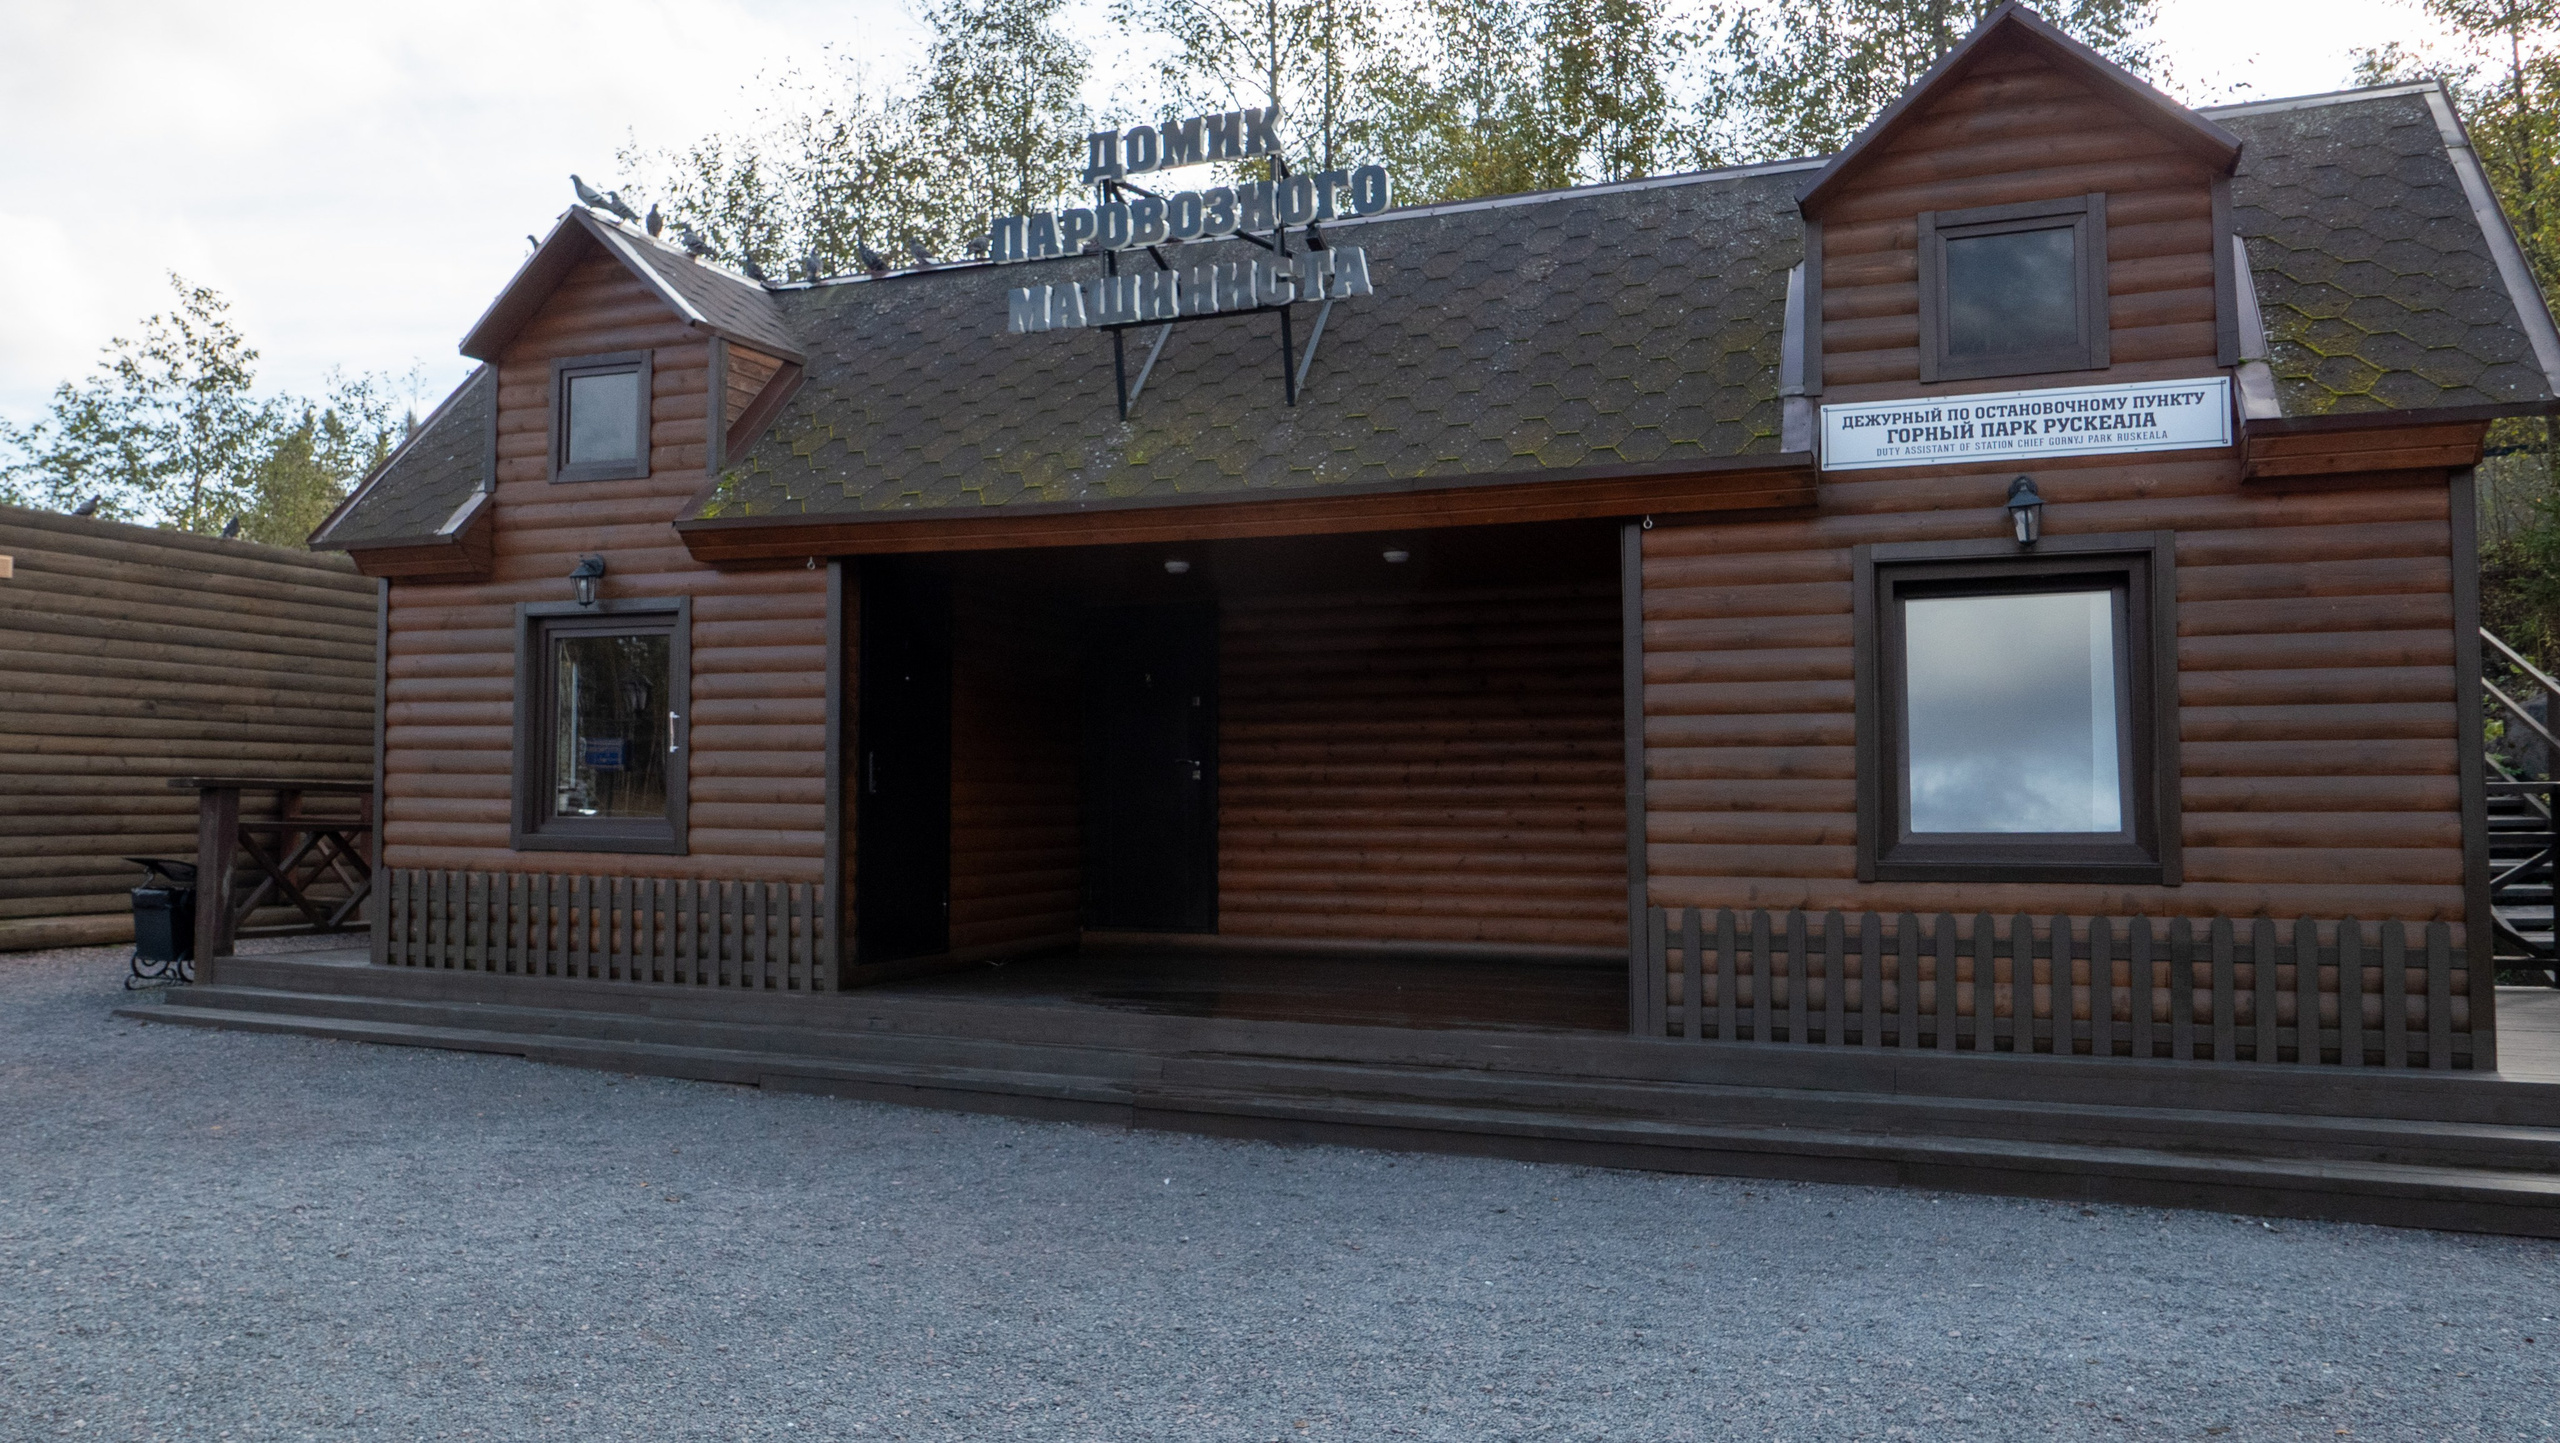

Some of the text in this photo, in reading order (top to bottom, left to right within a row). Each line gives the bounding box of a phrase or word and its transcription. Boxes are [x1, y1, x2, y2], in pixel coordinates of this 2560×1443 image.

[1084, 106, 1283, 184] ДОМИК
[992, 165, 1391, 264] ПАРОВОЗНОГО
[1008, 247, 1373, 333] МАШИНИСТА
[1842, 391, 2206, 430] ДЕЖУРНЫЙ ПО ОСТАНОВОЧНОМУ ПУНКТУ
[1887, 412, 2157, 444] ГОРНЫЙ ПАРК РУСКЕАЛА
[1876, 430, 2168, 457] DUTY ASSISTANT OF STATION CHIEF GORNYJ PARK RUSKEALA
